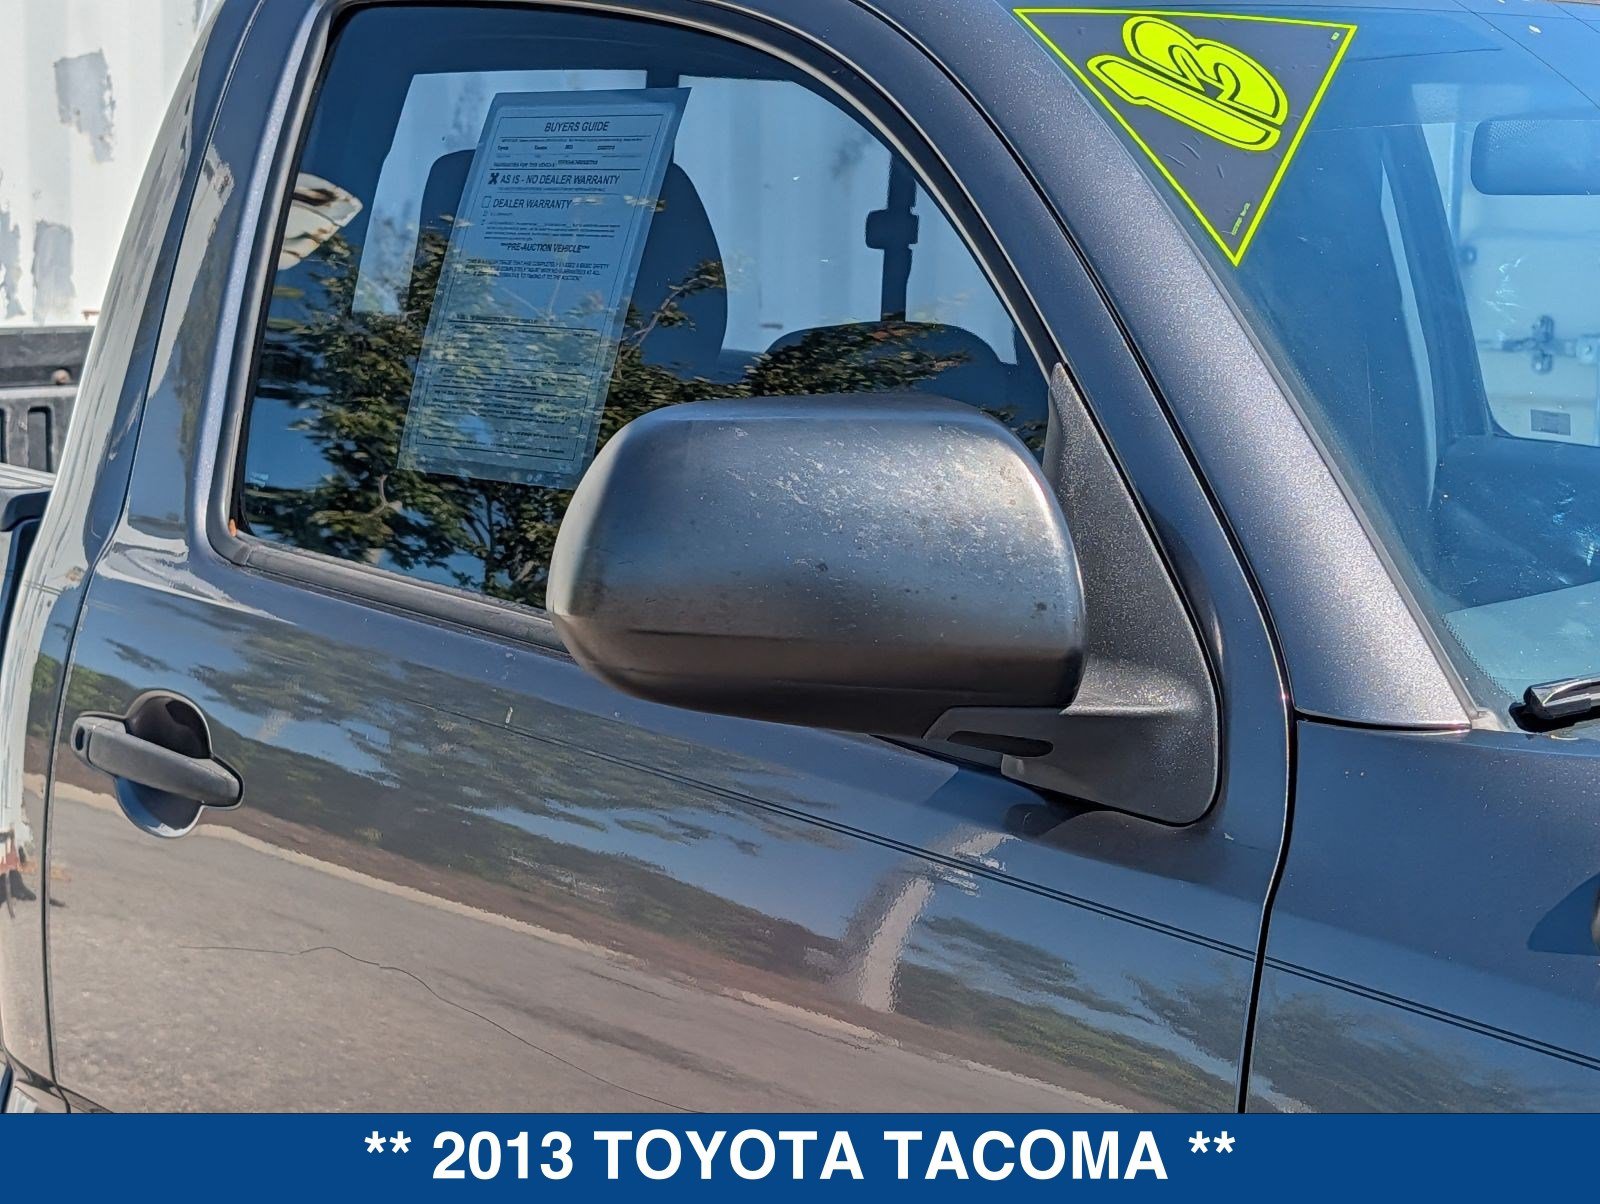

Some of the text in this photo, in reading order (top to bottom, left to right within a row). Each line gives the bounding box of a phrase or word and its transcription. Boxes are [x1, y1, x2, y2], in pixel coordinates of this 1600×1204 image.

[544, 120, 610, 133] BUYERS GUIDE
[500, 174, 511, 184] AS
[511, 174, 521, 184] IS
[525, 175, 539, 185] NO
[540, 174, 573, 185] DEALER
[572, 174, 620, 185] WARRANTY
[492, 199, 574, 209] DEALER WARRANTY
